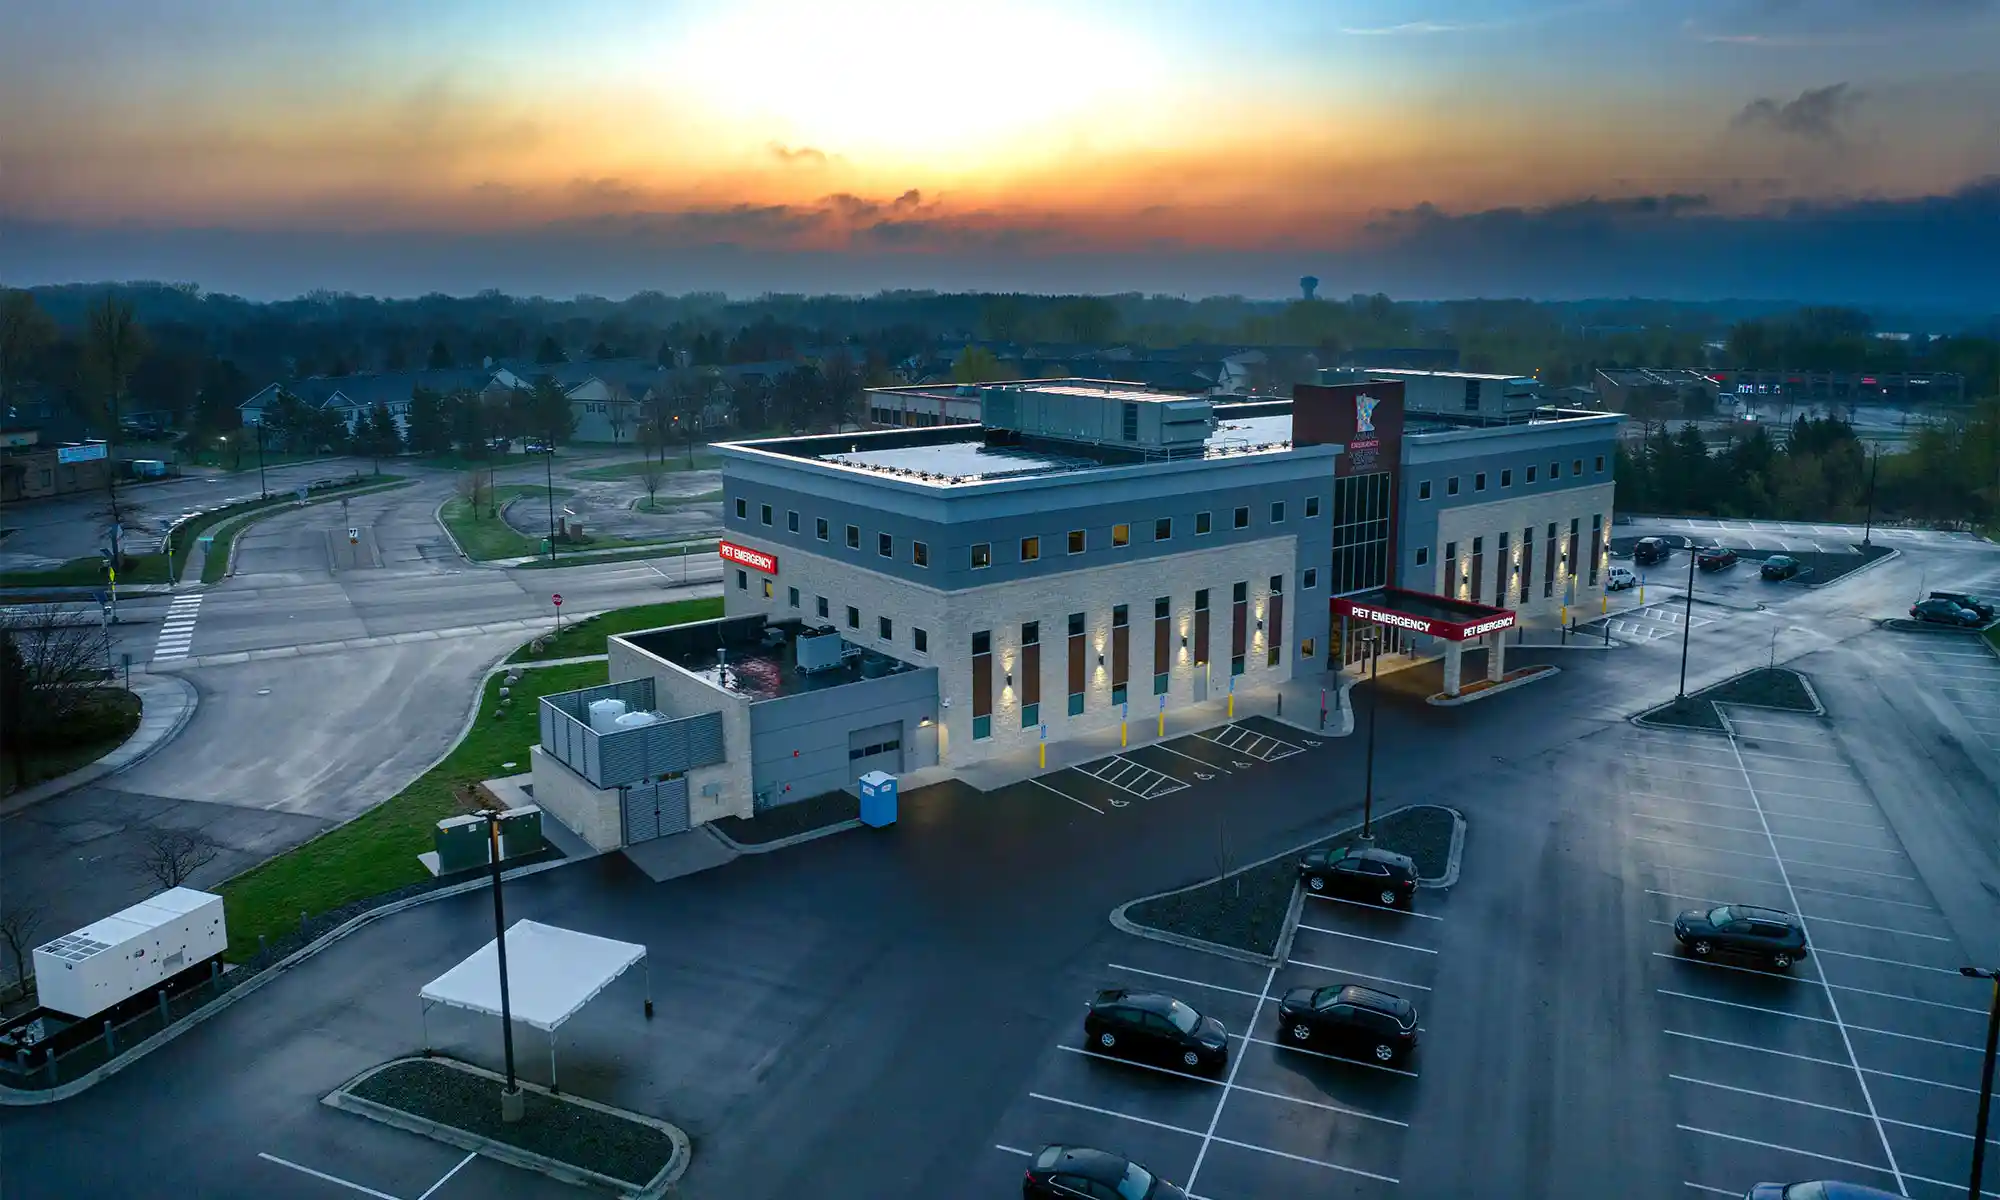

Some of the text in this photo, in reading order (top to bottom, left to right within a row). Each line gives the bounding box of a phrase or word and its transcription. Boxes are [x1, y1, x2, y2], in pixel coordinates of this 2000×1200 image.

[721, 544, 772, 569] PET EMERGENCY
[1352, 606, 1431, 632] PET EMERGENCY
[1463, 616, 1514, 637] PET EMERGENCY
